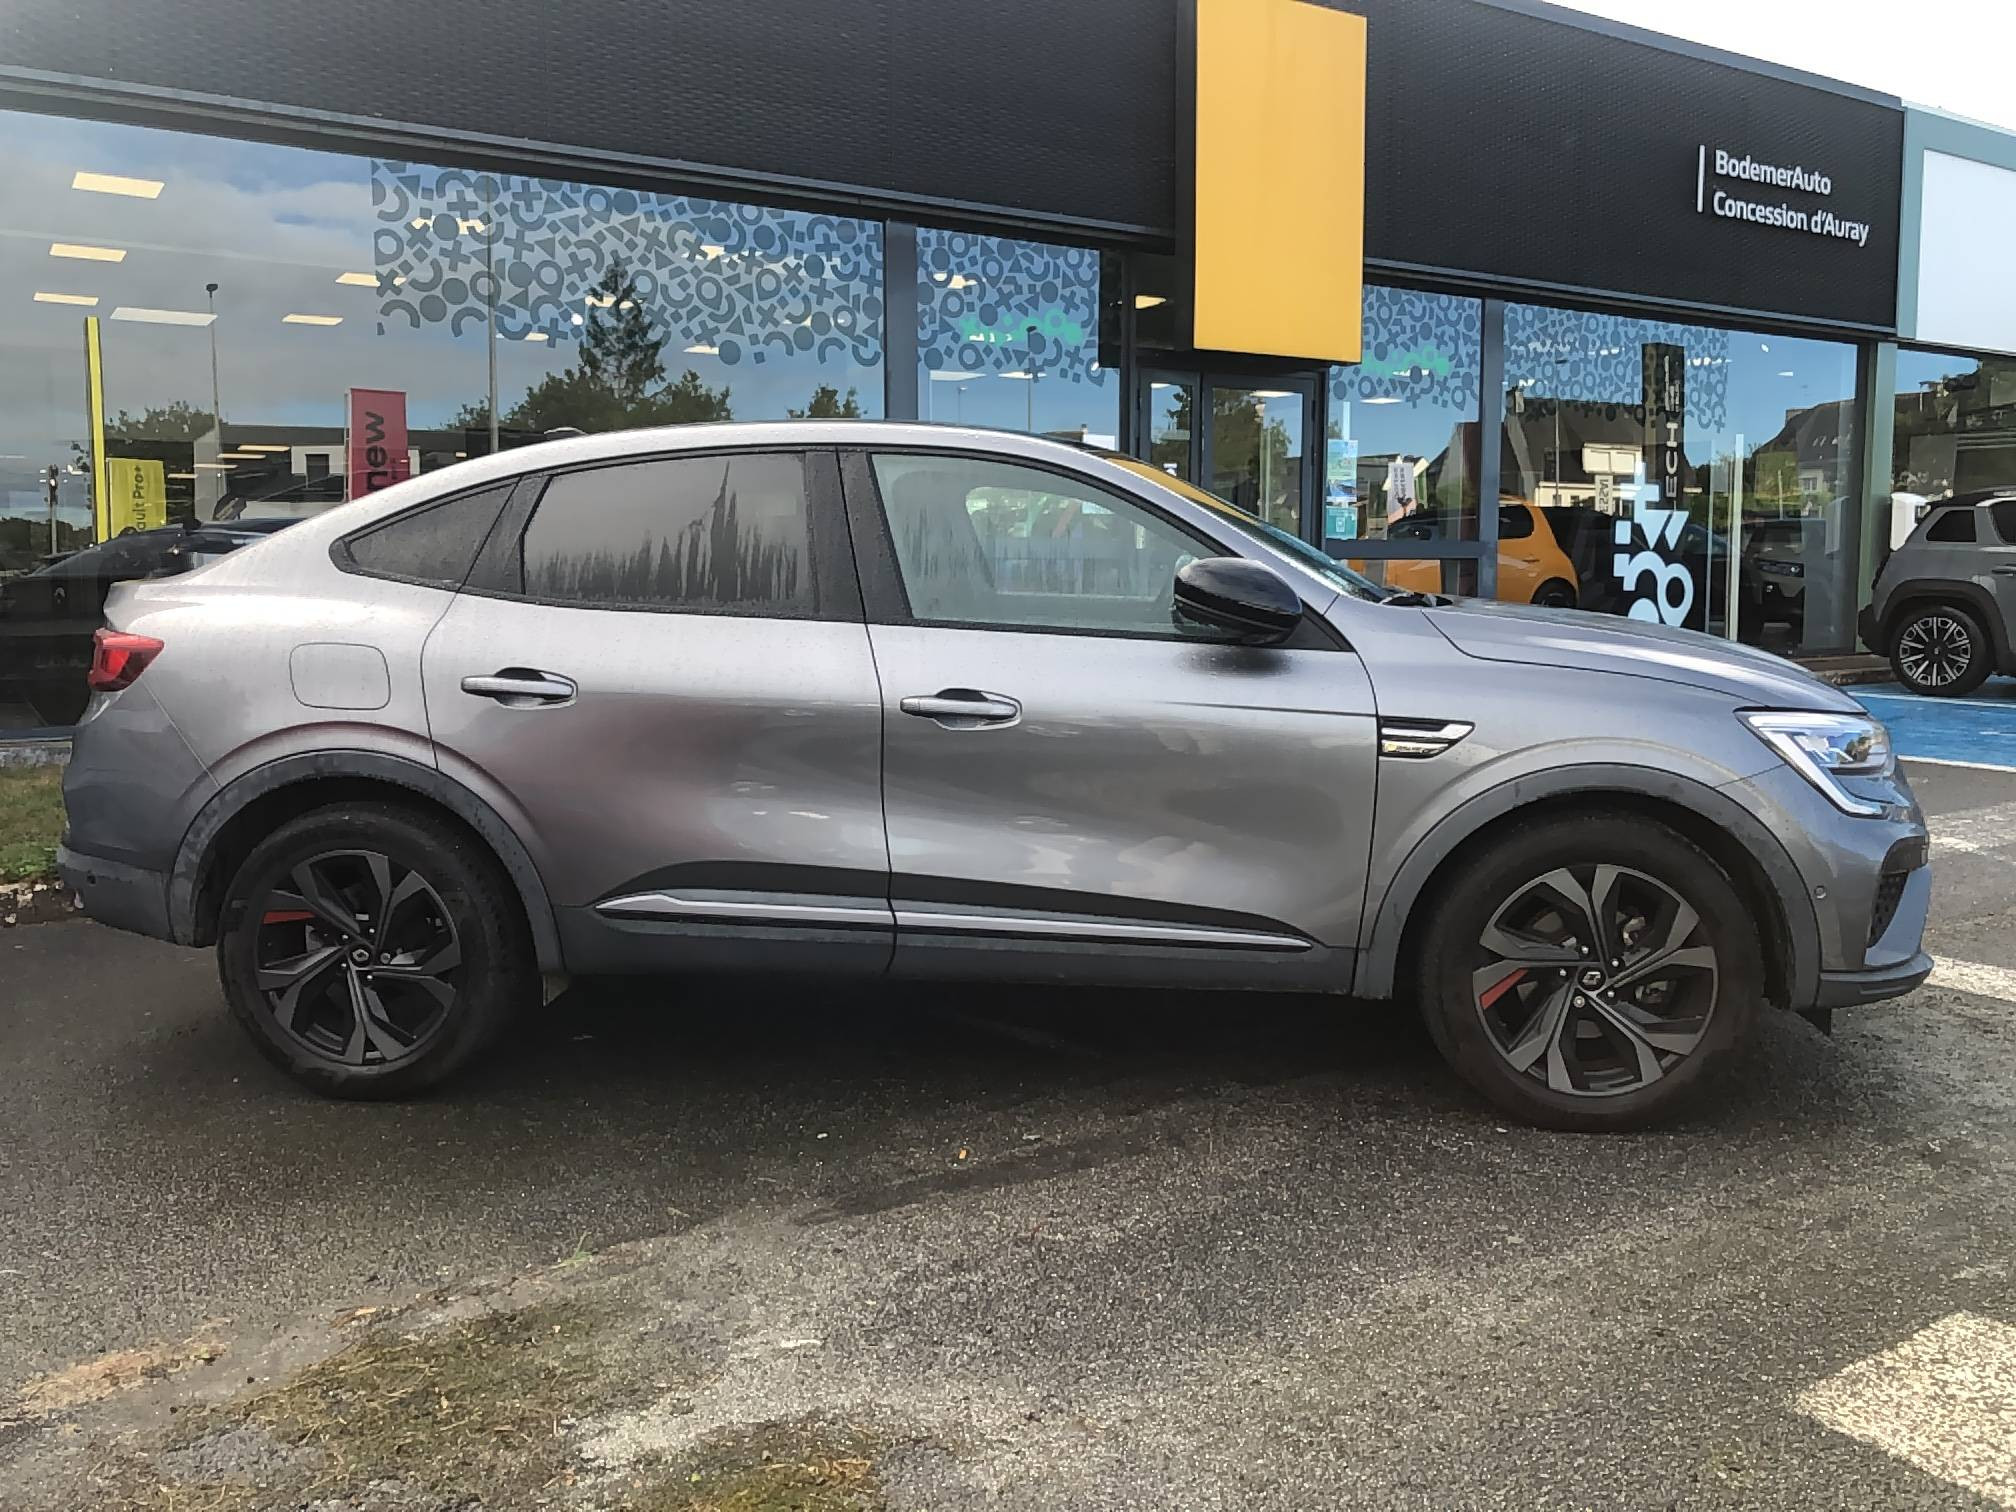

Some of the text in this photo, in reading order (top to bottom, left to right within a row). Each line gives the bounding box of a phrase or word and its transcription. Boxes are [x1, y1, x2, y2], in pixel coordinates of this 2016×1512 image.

[1715, 149, 1832, 195] BodemerAuto
[1713, 191, 1870, 248] Concession d'Auray
